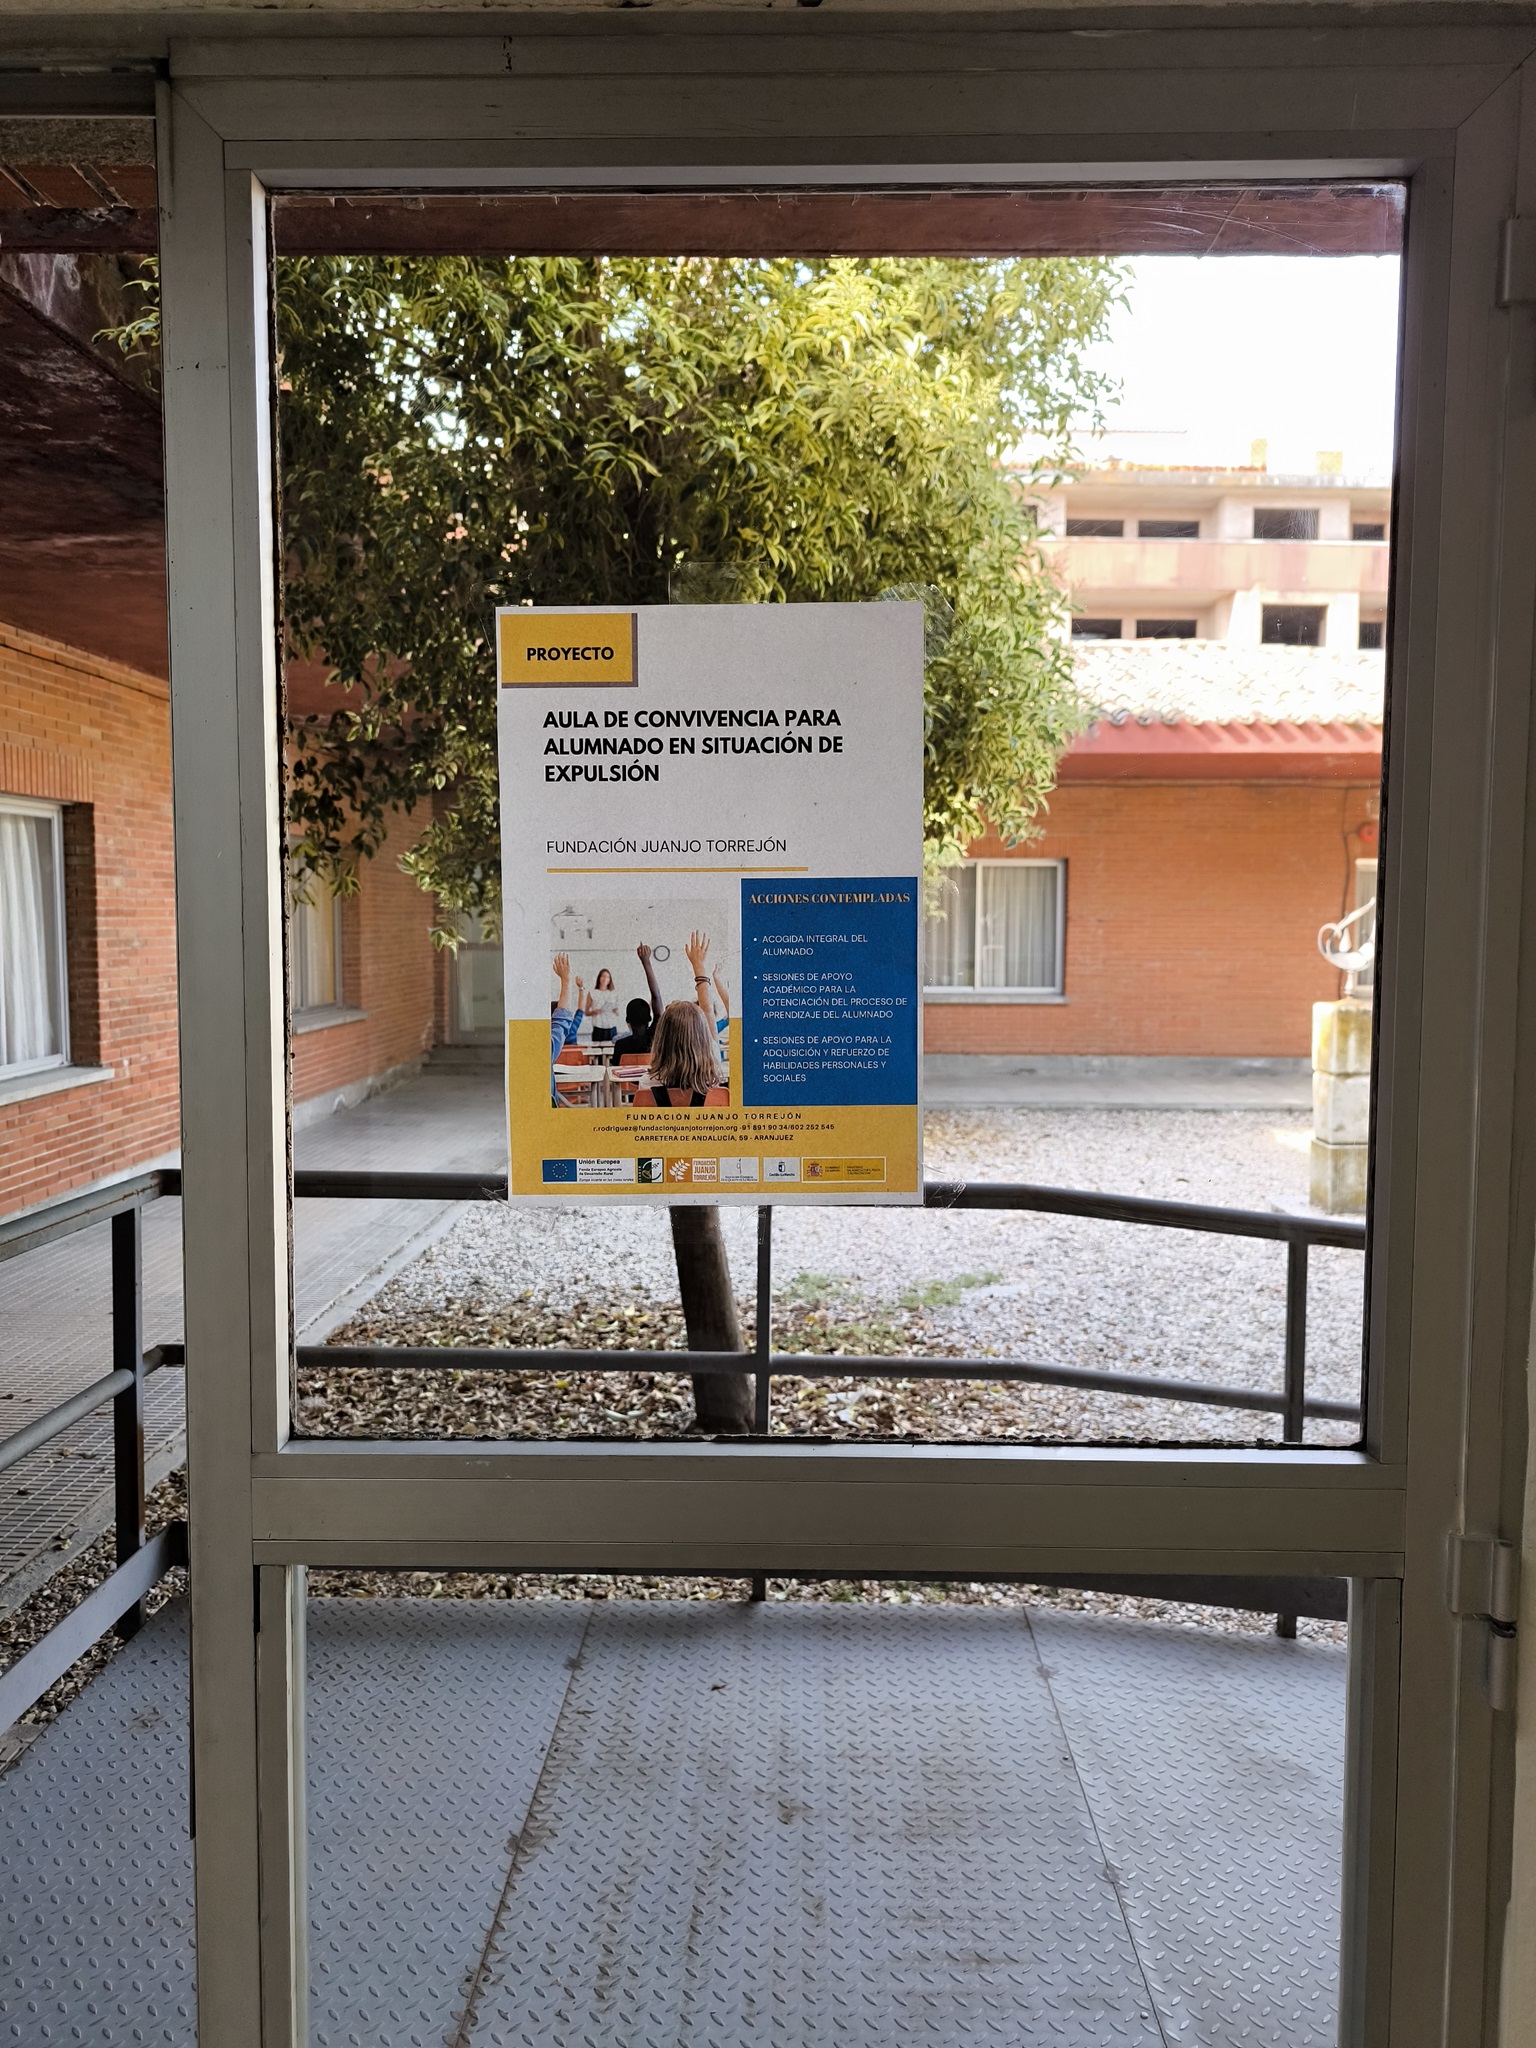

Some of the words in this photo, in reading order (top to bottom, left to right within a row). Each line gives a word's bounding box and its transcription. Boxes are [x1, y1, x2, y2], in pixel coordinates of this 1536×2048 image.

[526, 647, 614, 661] PROYECTO
[543, 710, 599, 728] AULA
[604, 710, 628, 728] DE
[634, 709, 779, 728] CONVIVENCIA
[785, 709, 841, 726] PARA
[544, 737, 663, 755] ALUMNADO
[670, 737, 695, 754] EN
[701, 731, 812, 754] SITUACIÓN
[819, 736, 843, 753] DE
[545, 760, 659, 782] EXPULSIÓN
[547, 838, 637, 854] FUNDACIÓN
[641, 840, 701, 854] JUANJO
[706, 836, 786, 853] TORREJÓN
[749, 894, 809, 904] ACCIONES
[812, 893, 910, 904] CONTEMPLADAS
[762, 948, 813, 956] ALUMNADO
[763, 984, 817, 994] ACADÉMICO
[763, 997, 829, 1006] POTENCIACIÓN
[763, 1047, 820, 1058] ADQUISICIÓN
[626, 1112, 690, 1120] FUNDACIÓN
